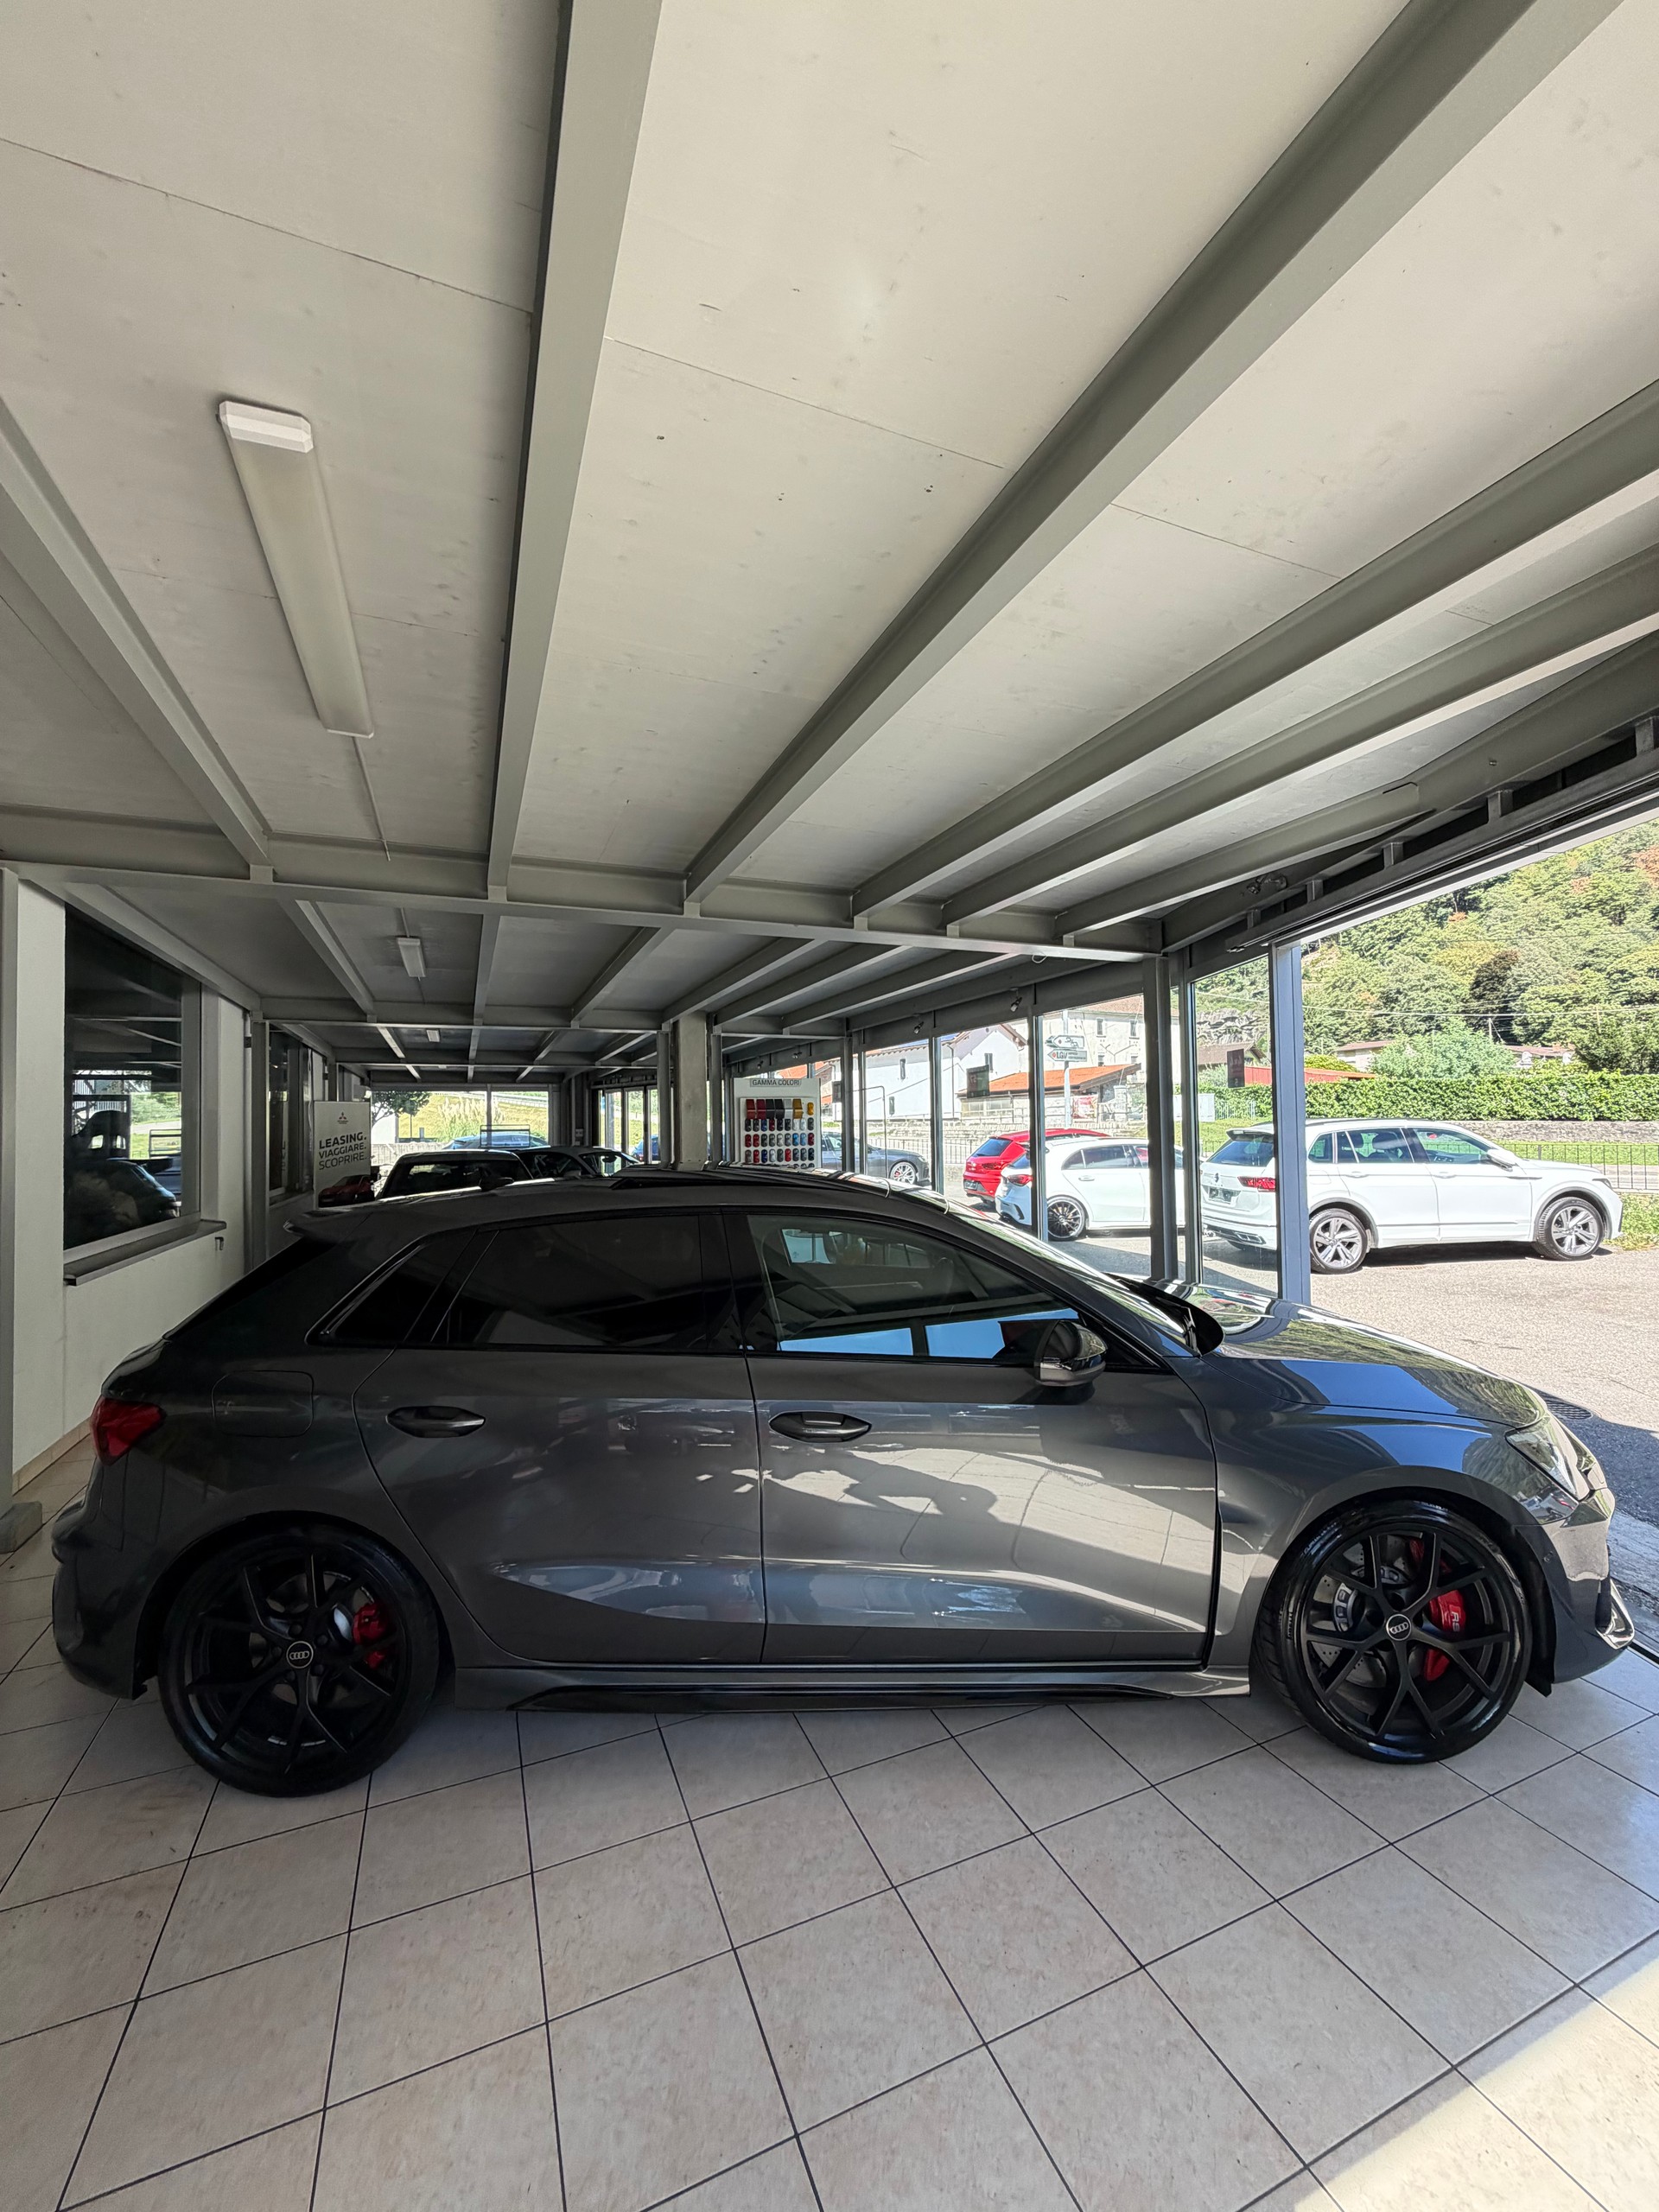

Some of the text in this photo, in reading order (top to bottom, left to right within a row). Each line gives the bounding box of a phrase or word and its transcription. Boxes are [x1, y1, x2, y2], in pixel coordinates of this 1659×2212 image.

[319, 1132, 367, 1149] LEASING.
[319, 1142, 367, 1159] VIAGGIARE.
[319, 1152, 367, 1170] SCOPRIRE.
